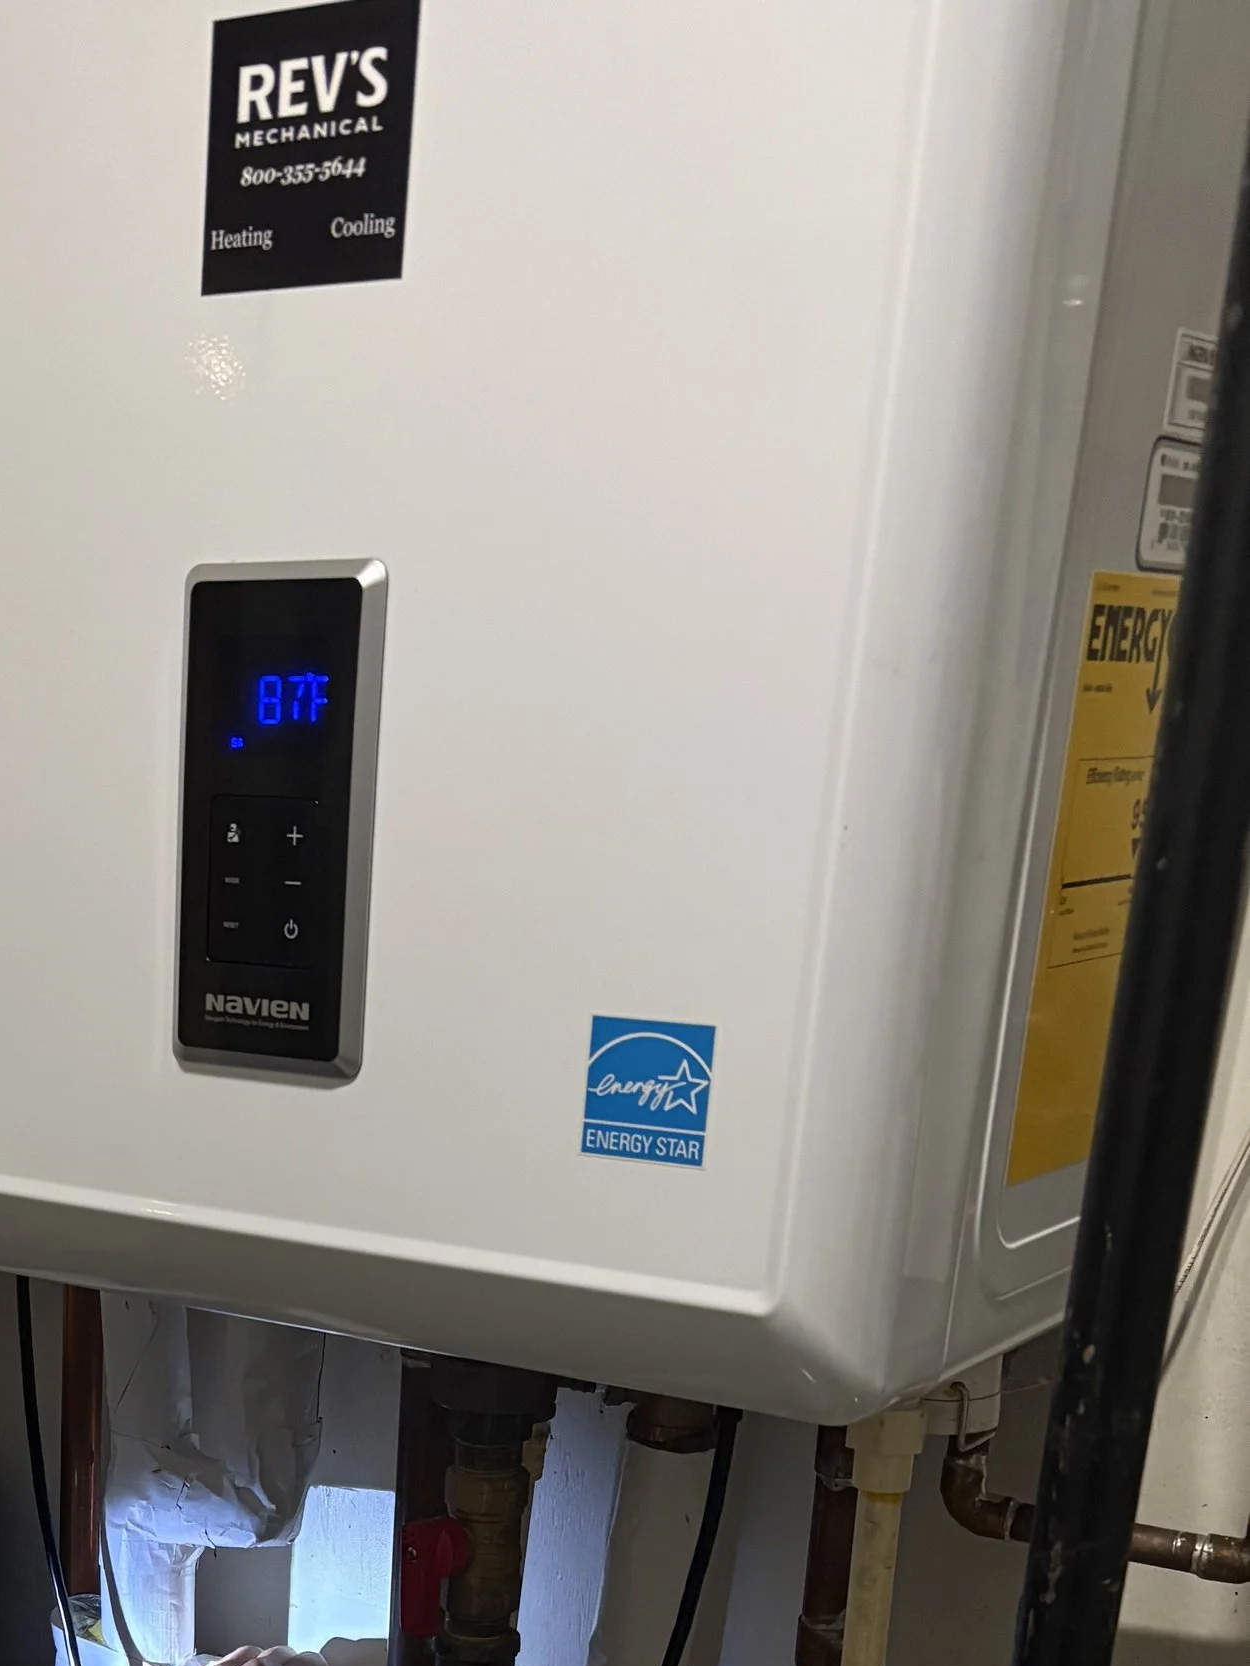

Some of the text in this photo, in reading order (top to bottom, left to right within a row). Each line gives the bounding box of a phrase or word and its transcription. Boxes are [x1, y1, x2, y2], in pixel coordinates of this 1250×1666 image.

[236, 46, 389, 124] REV'S
[234, 115, 384, 149] MECHANICAL
[240, 155, 366, 187] 800-355-5644
[210, 213, 396, 250] Heating Cooling
[589, 1073, 676, 1111] energy
[585, 1128, 700, 1160] ENERGY STAR
